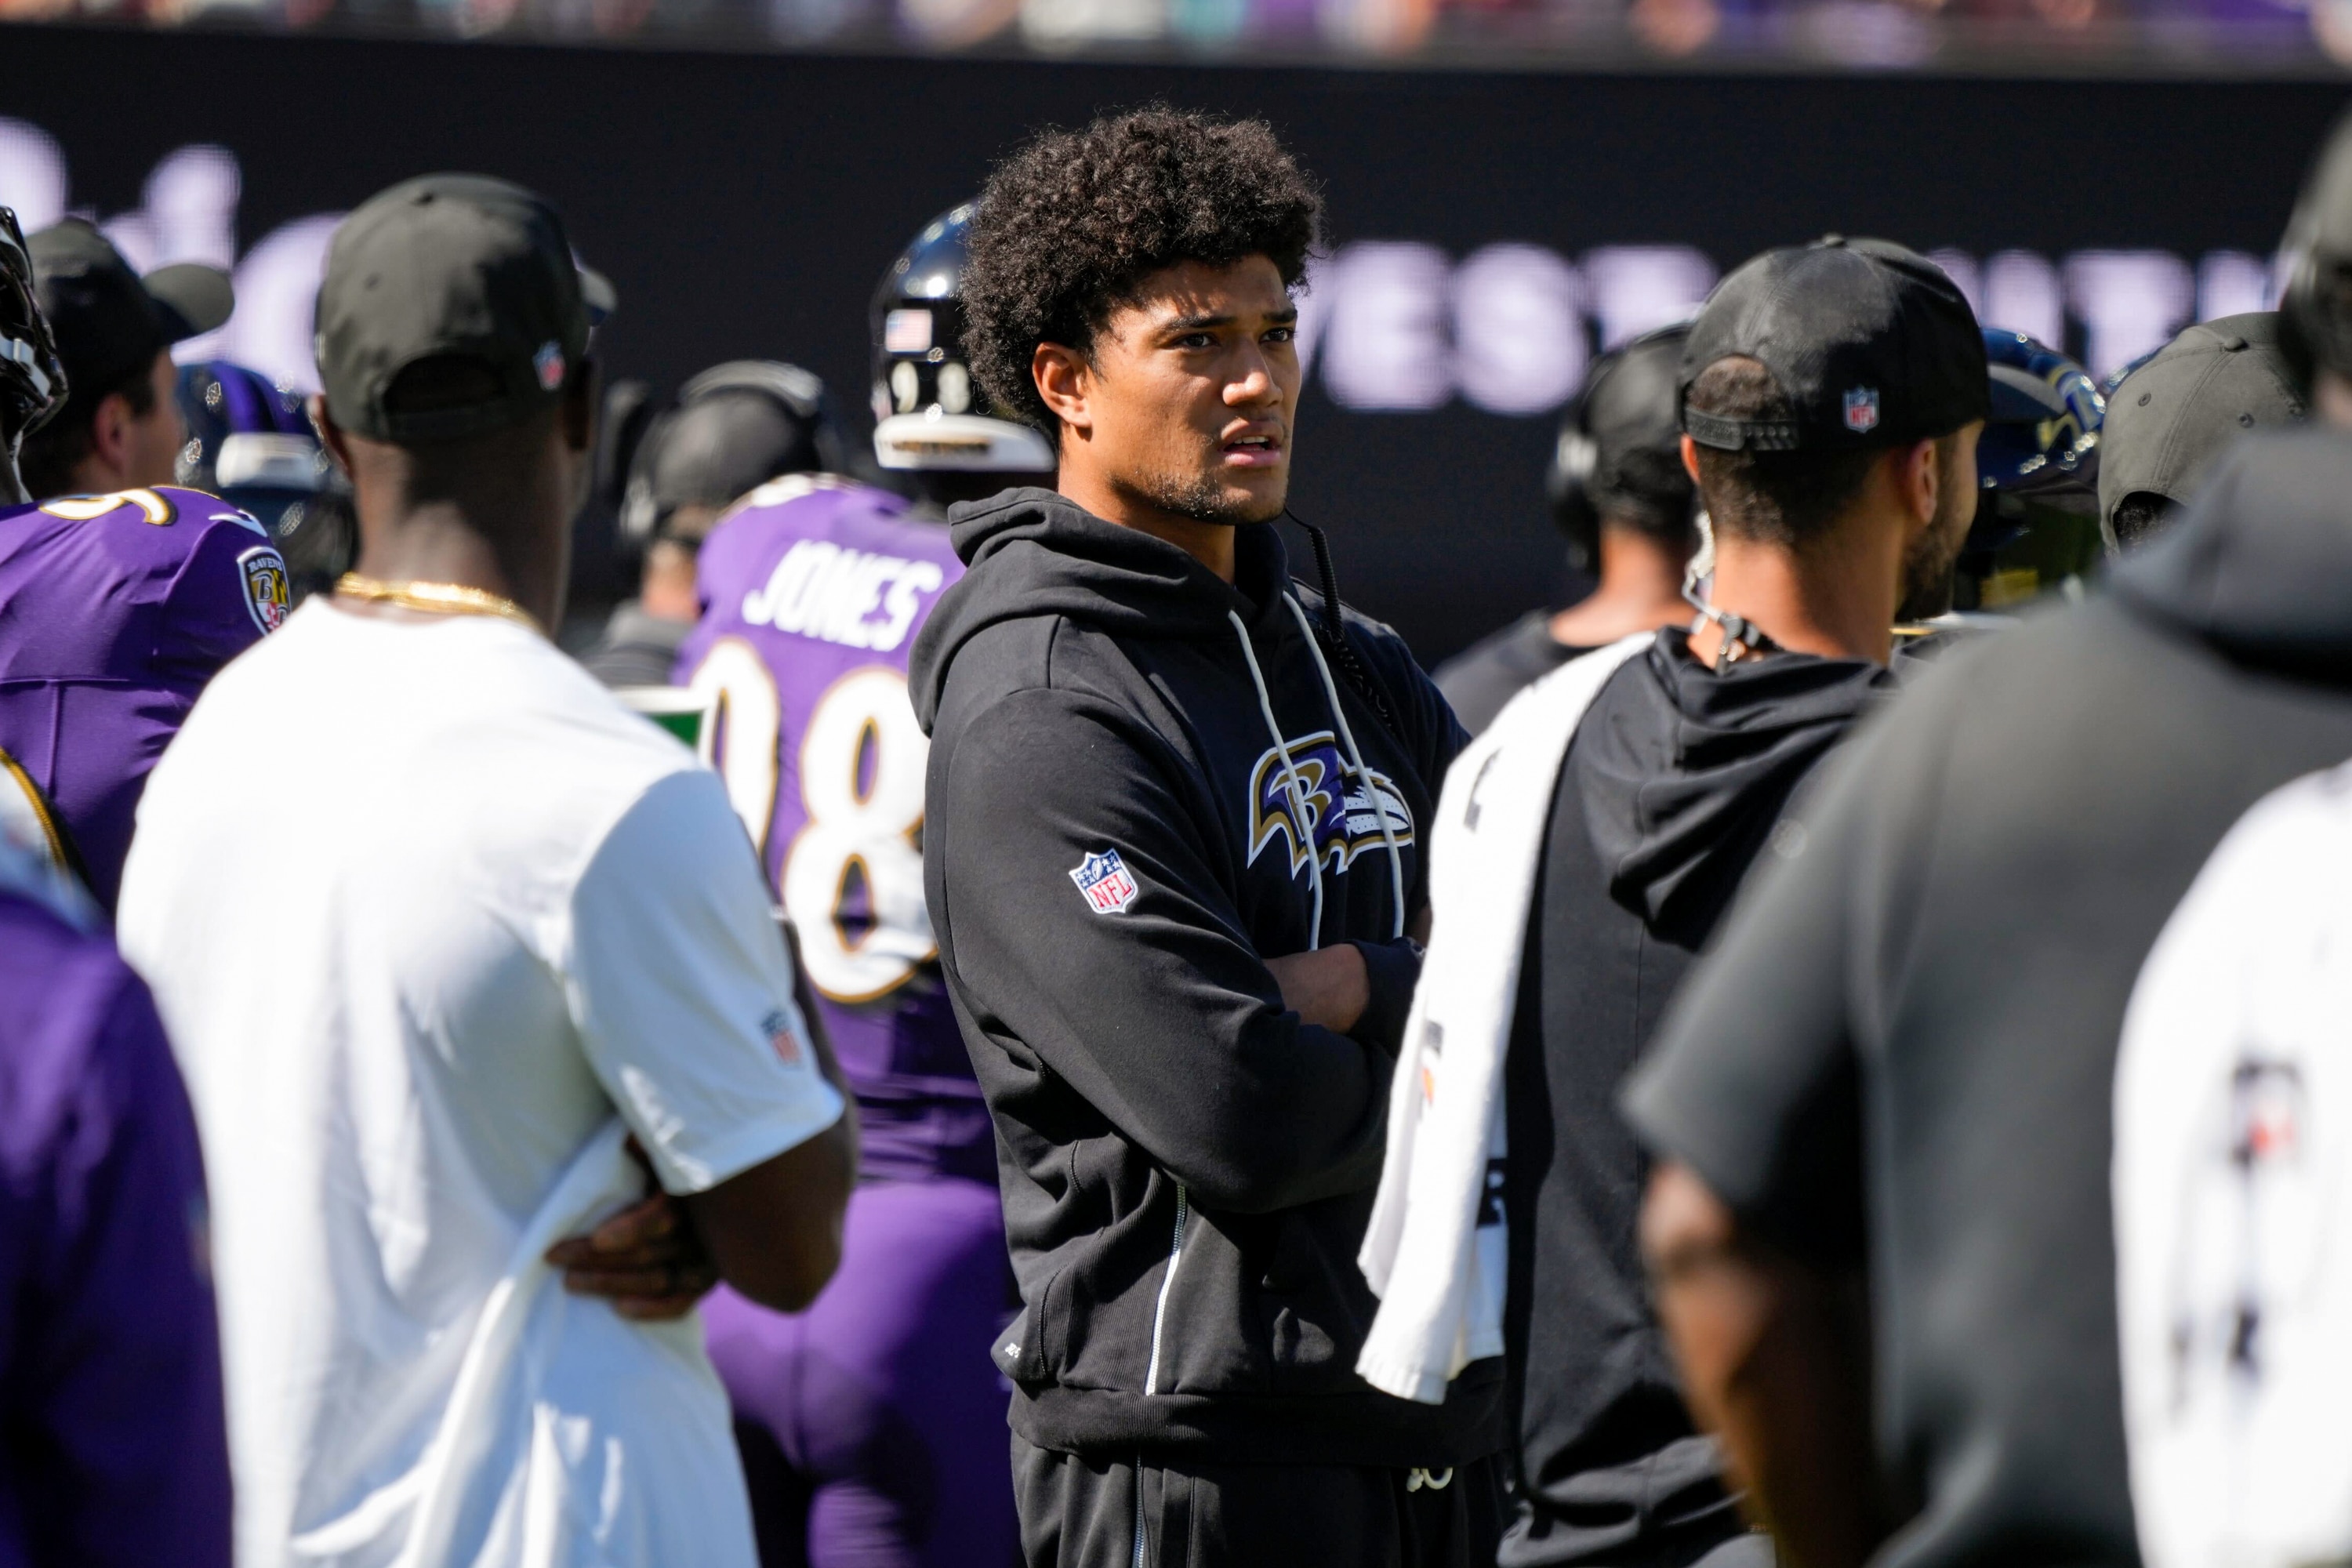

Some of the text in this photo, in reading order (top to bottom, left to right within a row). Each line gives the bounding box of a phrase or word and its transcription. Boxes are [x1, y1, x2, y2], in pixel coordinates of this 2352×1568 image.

[251, 570, 274, 603] B
[742, 539, 942, 652] JONES
[1088, 873, 1132, 908] NFL
